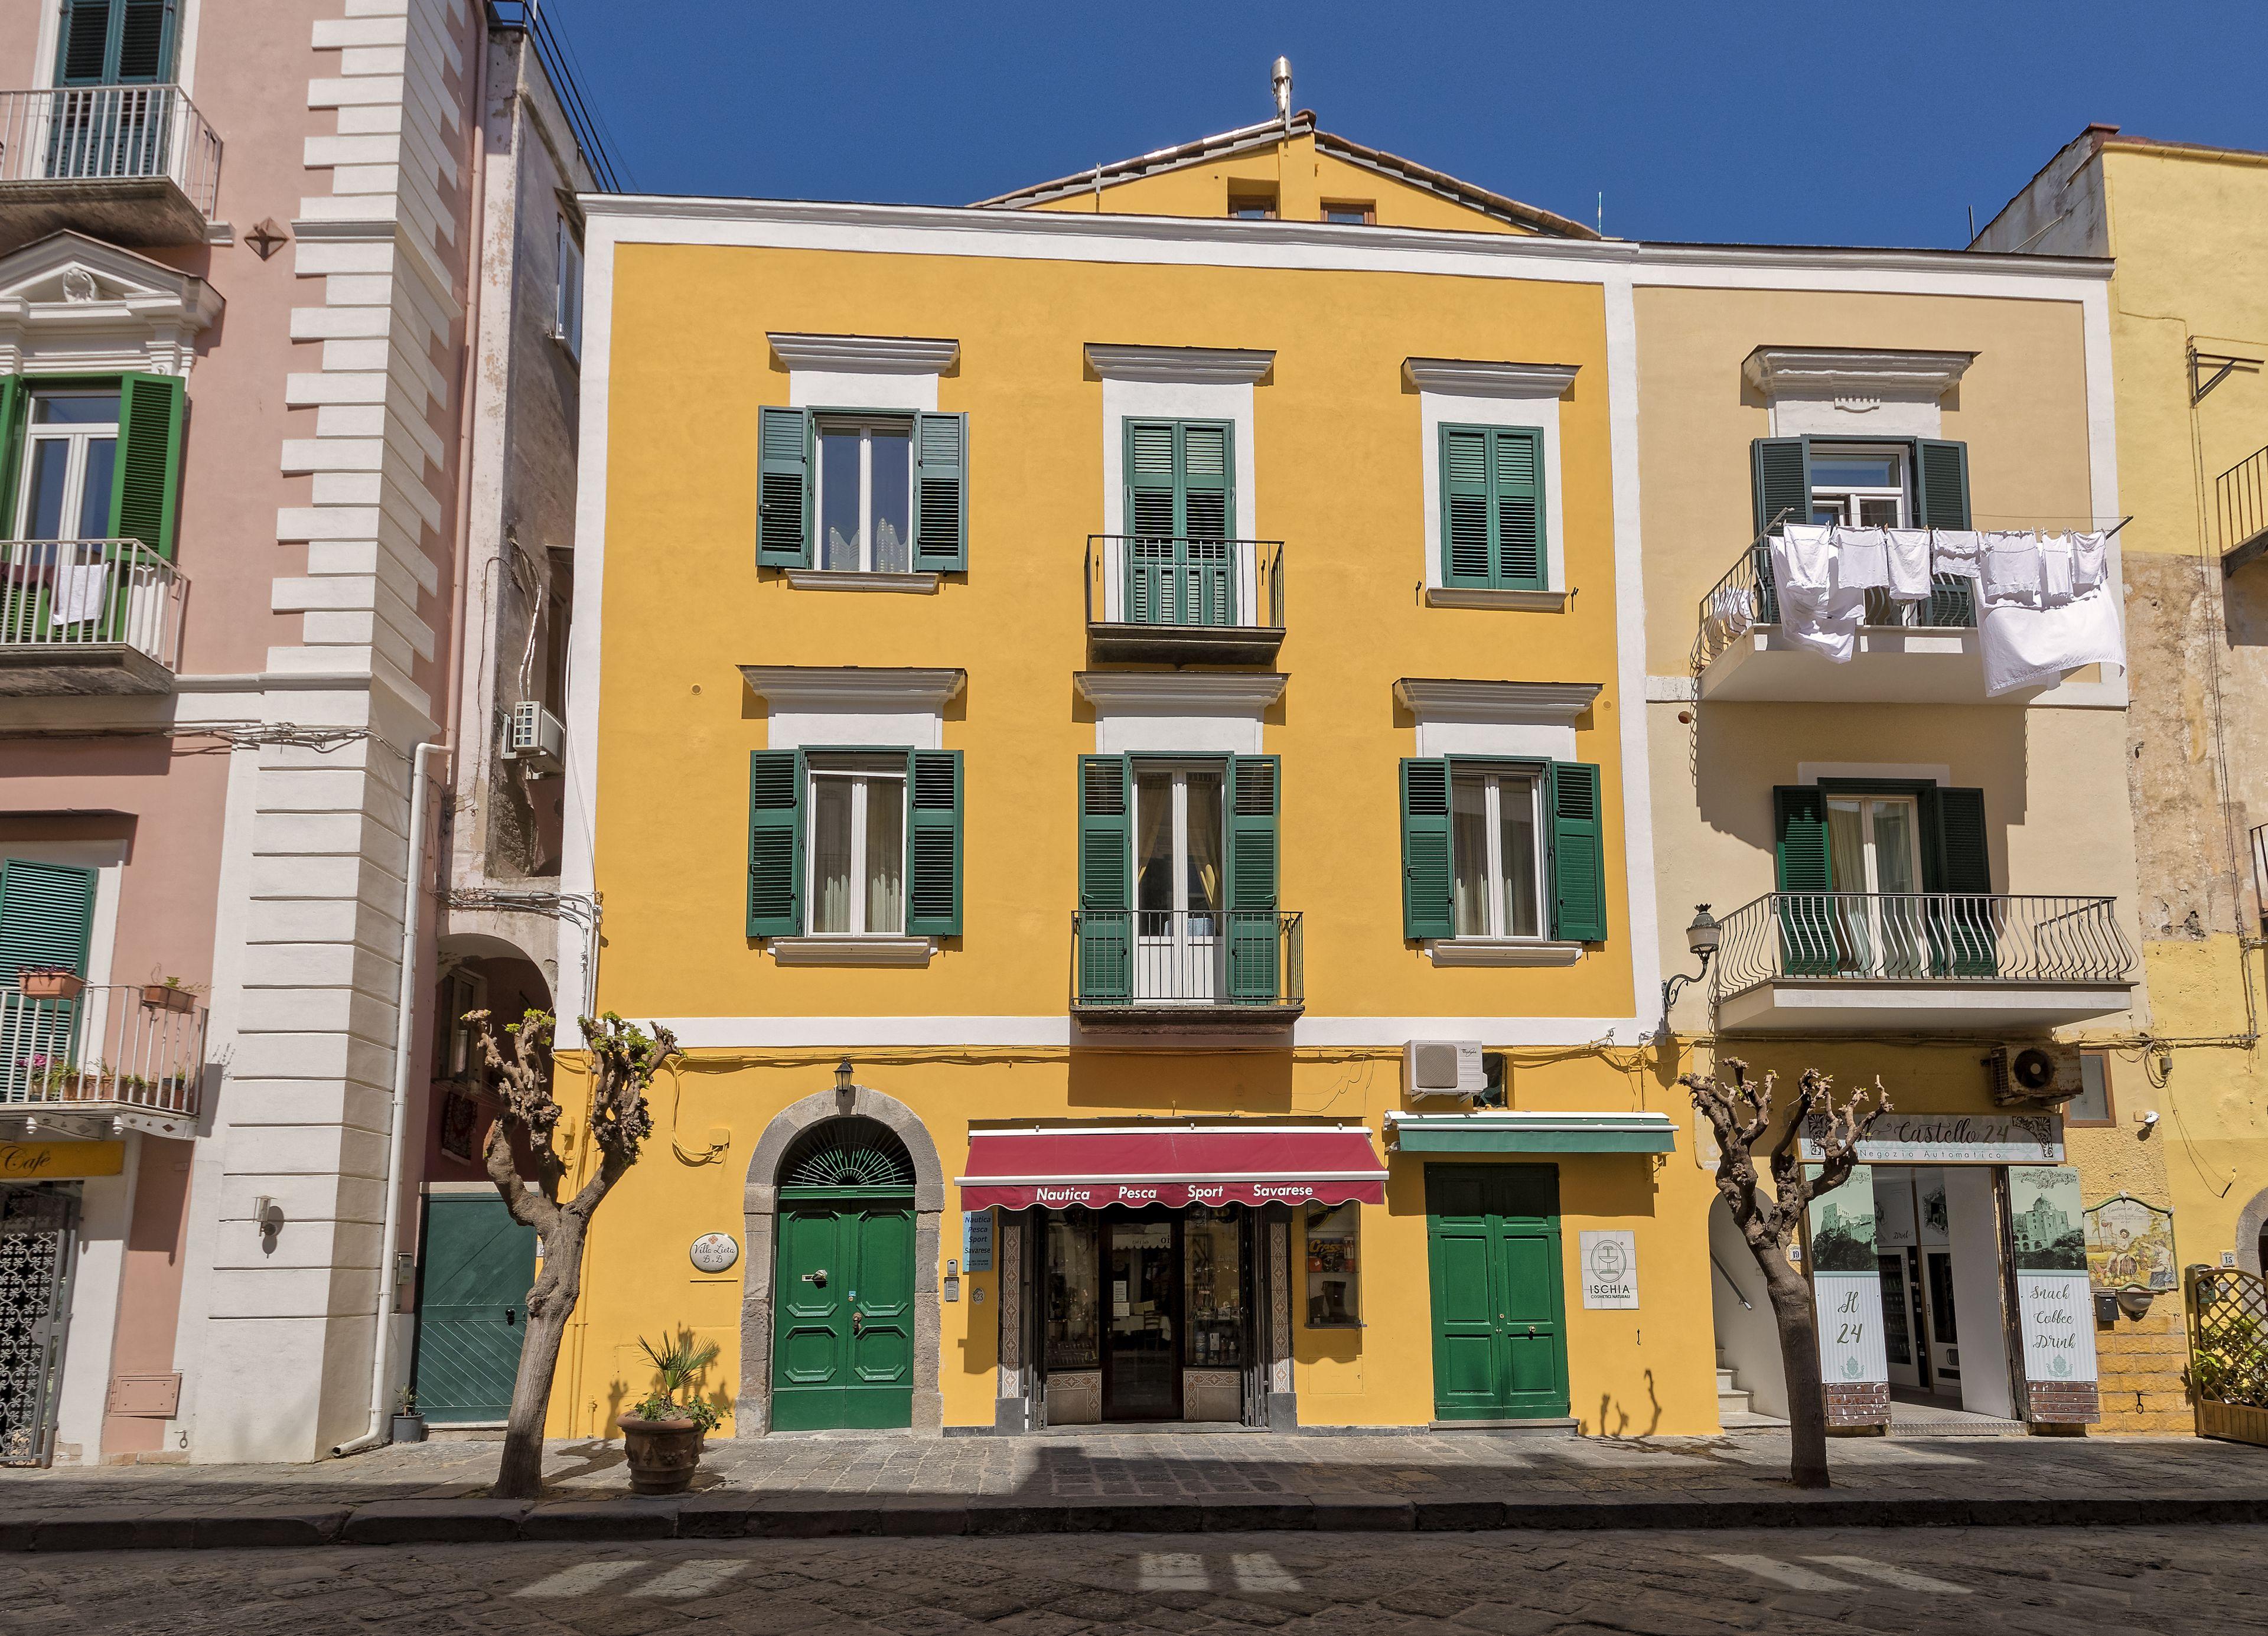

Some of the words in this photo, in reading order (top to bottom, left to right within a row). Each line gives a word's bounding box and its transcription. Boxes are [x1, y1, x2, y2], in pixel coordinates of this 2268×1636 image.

[1894, 1118, 1980, 1143] Castello
[1982, 1125, 2009, 1144] 24
[1860, 1149, 1914, 1159] Negozio
[1924, 1149, 2002, 1158] Automatico
[1036, 1187, 1090, 1201] Nautica
[1118, 1186, 1157, 1199] Pesca
[1188, 1185, 1224, 1200] Sport
[1253, 1184, 1314, 1197] Savarese
[694, 1243, 712, 1254] Villa
[713, 1243, 735, 1254] Lieta
[1793, 1250, 1800, 1259] 19
[1589, 1285, 1630, 1293] ISCHIA
[2030, 1284, 2070, 1299] Snack
[976, 1293, 983, 1301] 23
[1837, 1291, 1860, 1313] H
[1837, 1323, 1863, 1344] 24
[2033, 1333, 2076, 1348] Drink
